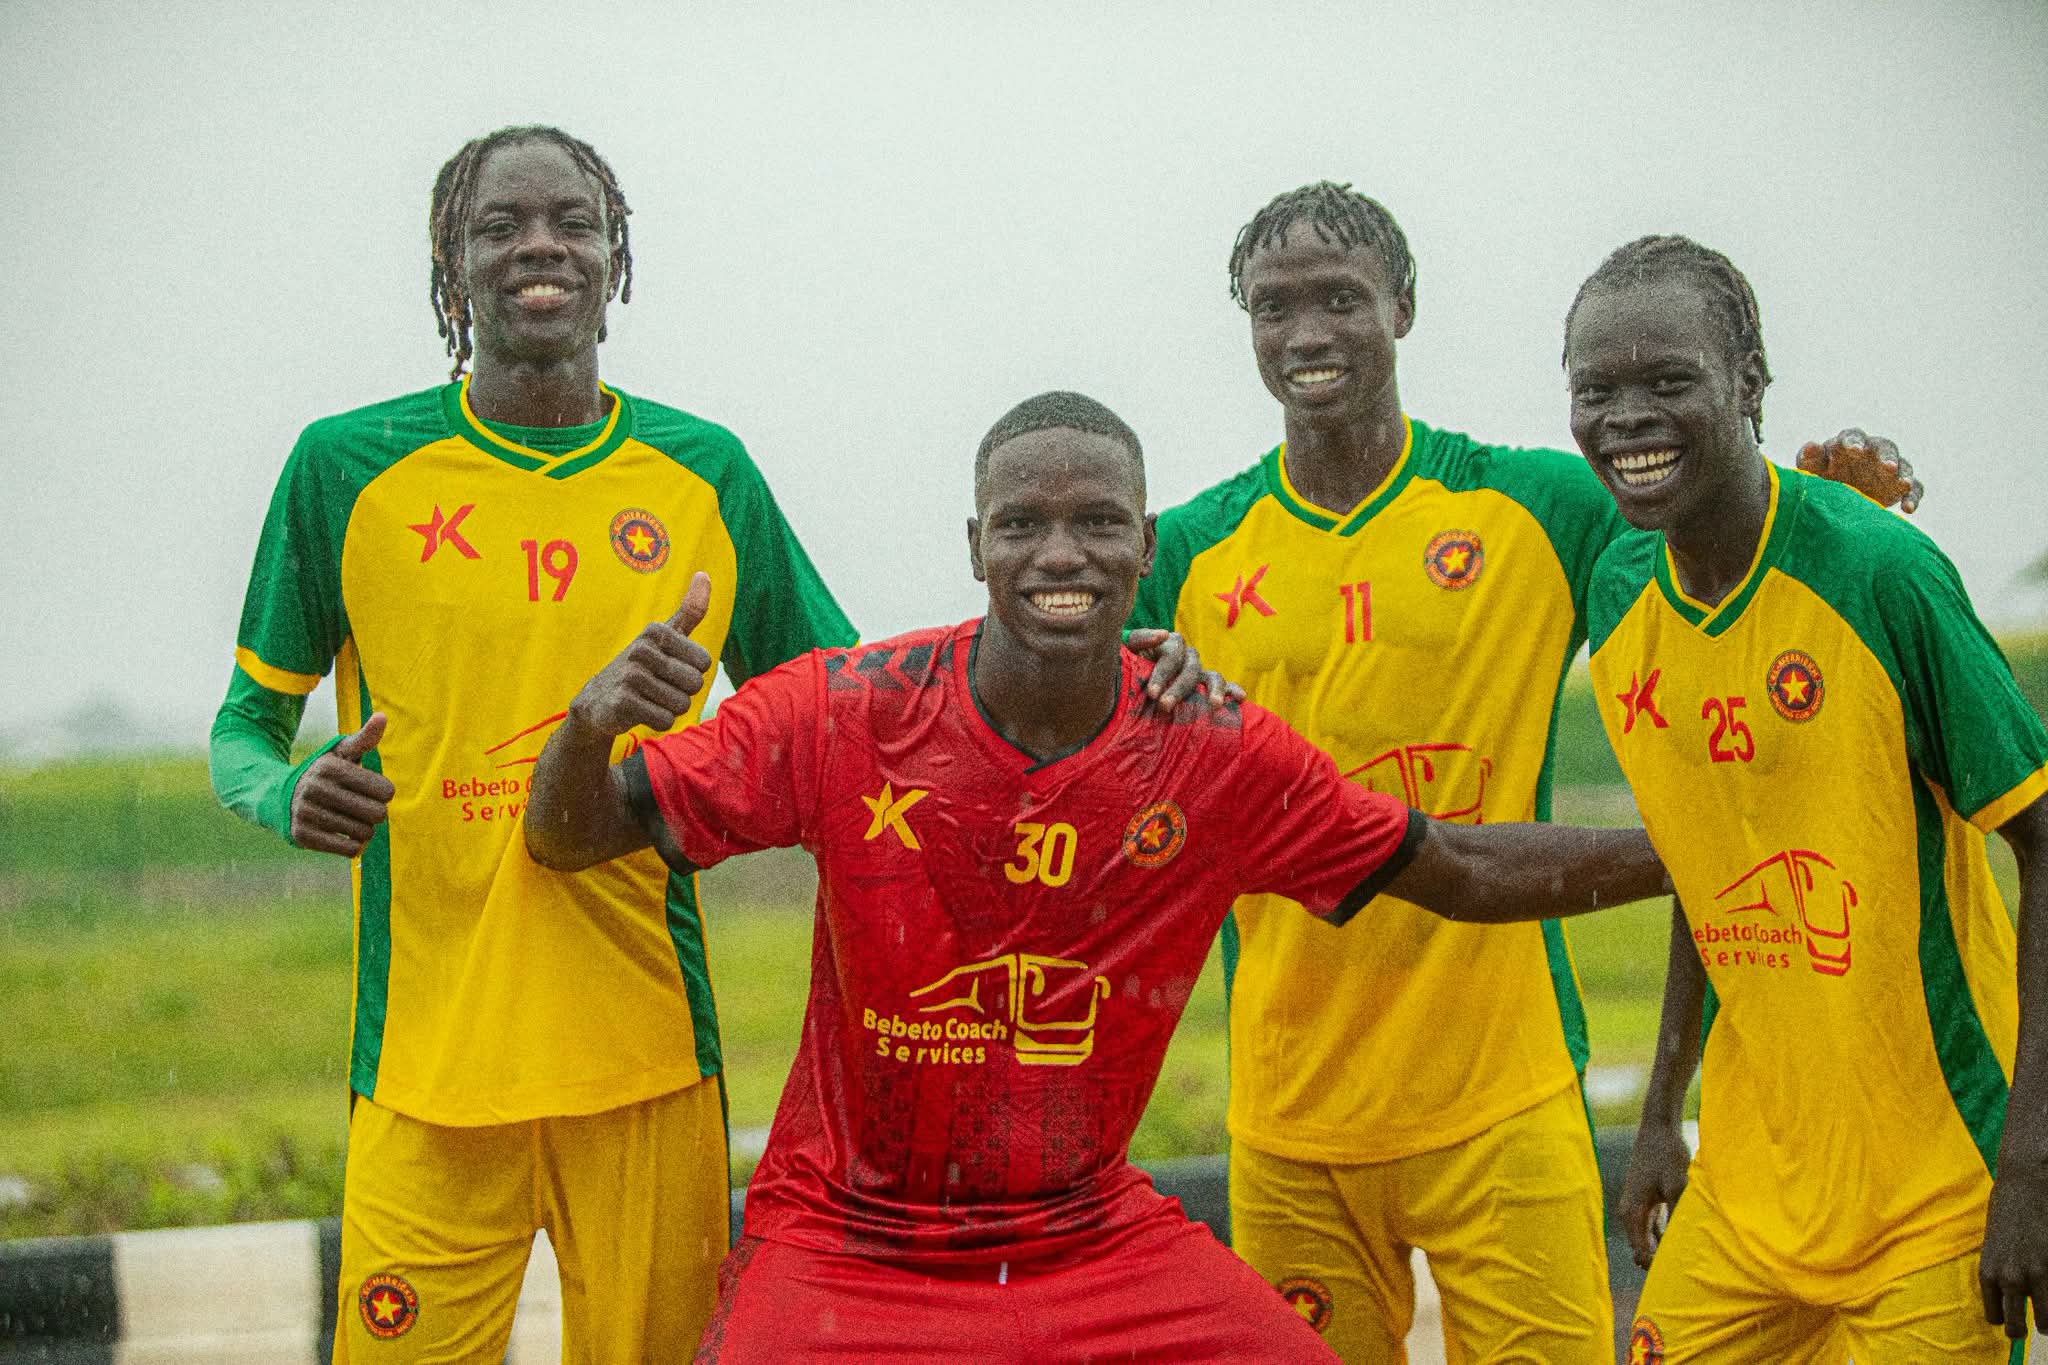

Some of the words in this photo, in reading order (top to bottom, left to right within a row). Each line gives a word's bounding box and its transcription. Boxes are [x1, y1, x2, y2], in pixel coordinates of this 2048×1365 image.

[520, 539, 579, 602] 19
[1339, 580, 1373, 644] 11
[1701, 696, 1755, 763] 25
[442, 776, 520, 799] Bebeto
[1004, 822, 1078, 887] 30
[1693, 922, 1753, 943] ebeto
[863, 1007, 943, 1041] Bebeto
[945, 1017, 1008, 1040] Coach
[876, 1036, 987, 1064] Services
